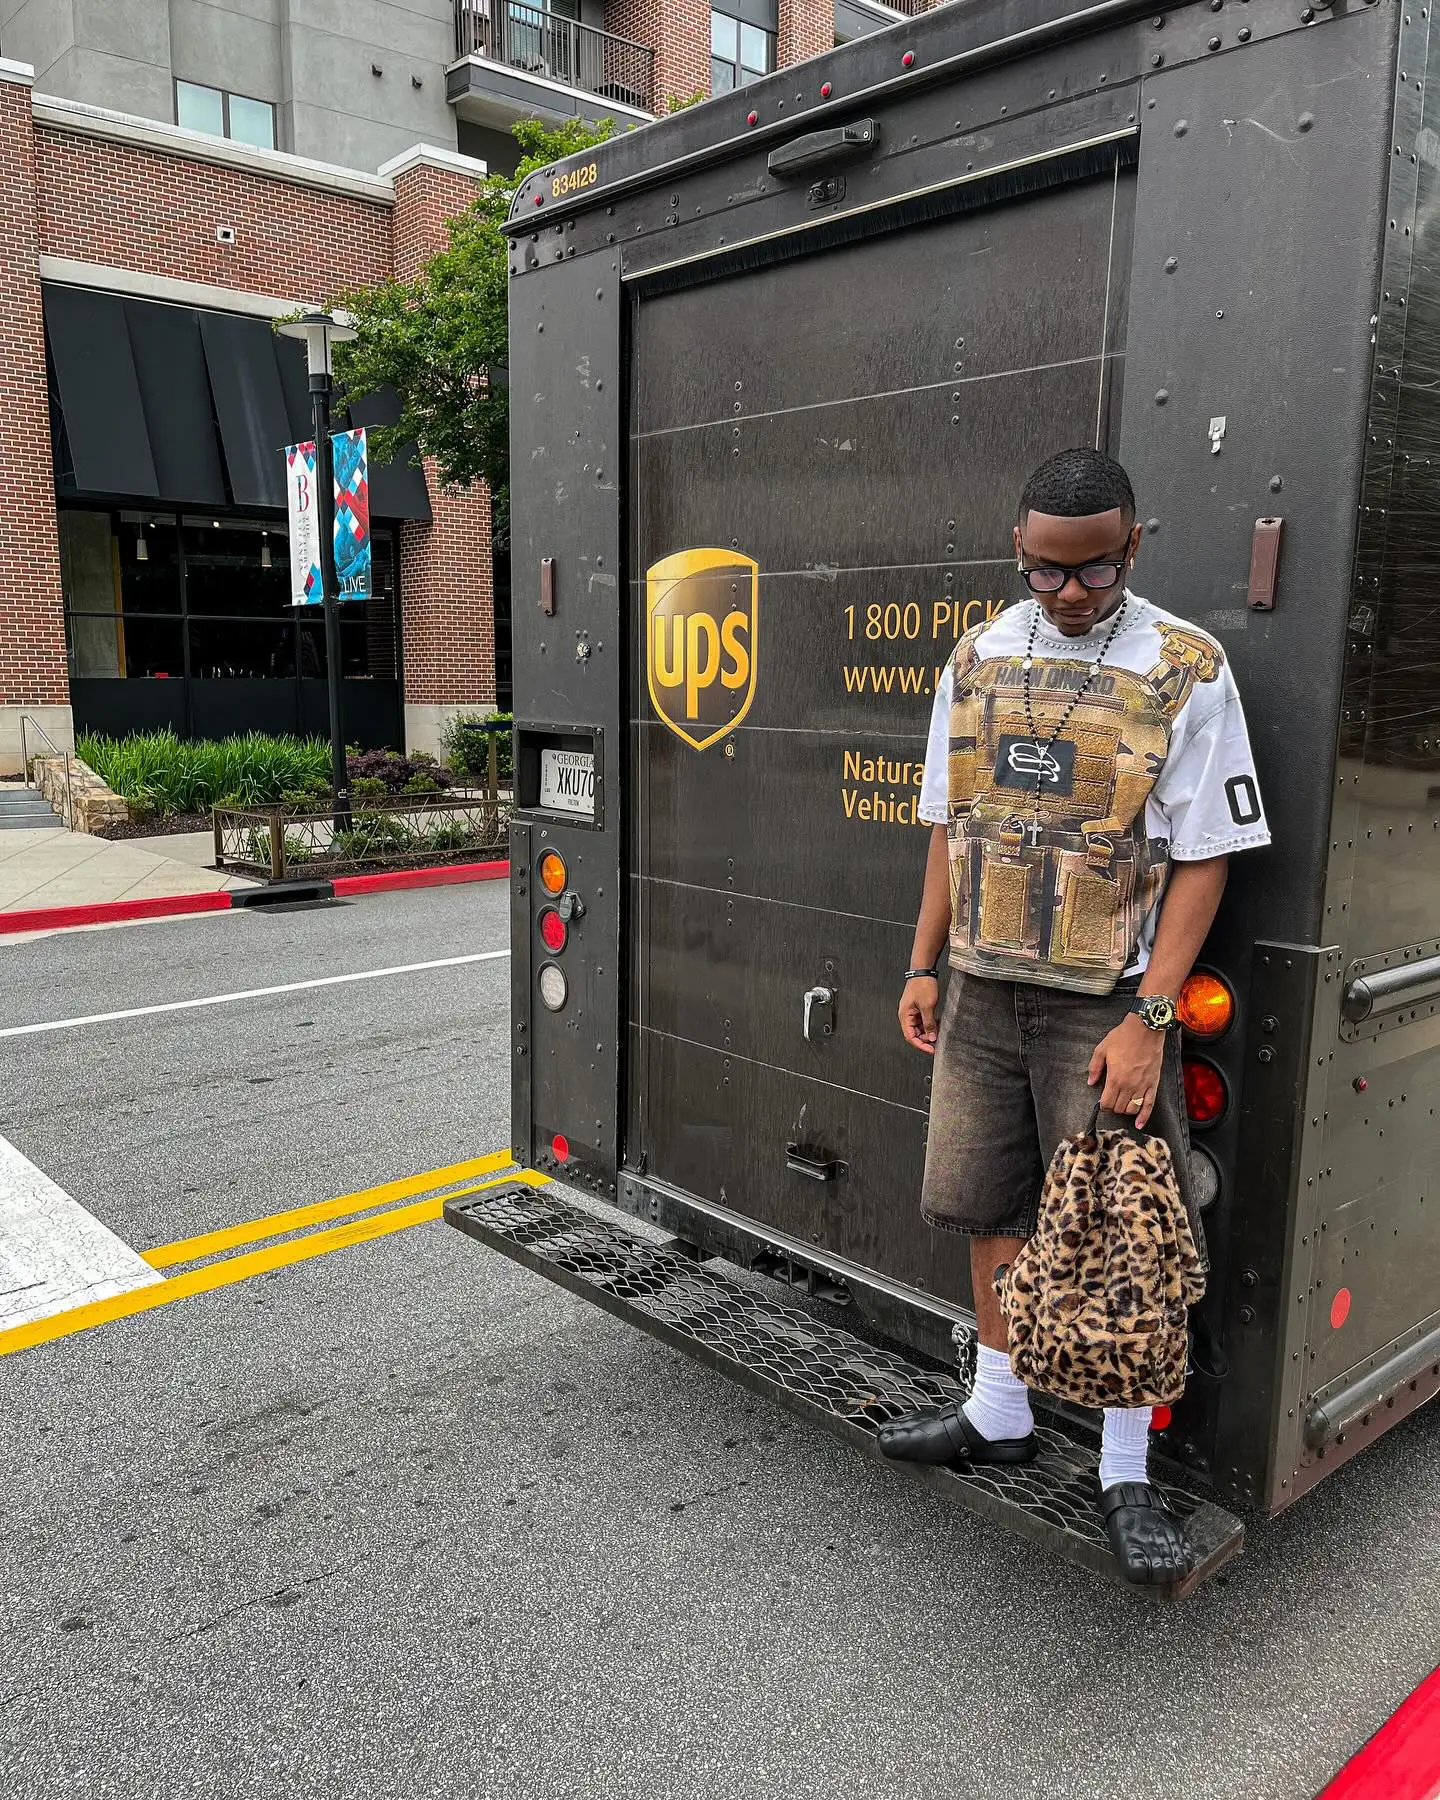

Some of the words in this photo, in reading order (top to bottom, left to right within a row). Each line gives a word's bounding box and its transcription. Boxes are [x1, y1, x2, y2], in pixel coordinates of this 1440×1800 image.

[552, 163, 597, 197] 834128
[343, 575, 366, 592] LIVE
[865, 602, 921, 640] 800
[654, 611, 749, 719] ups
[842, 789, 932, 827] Vehicl
